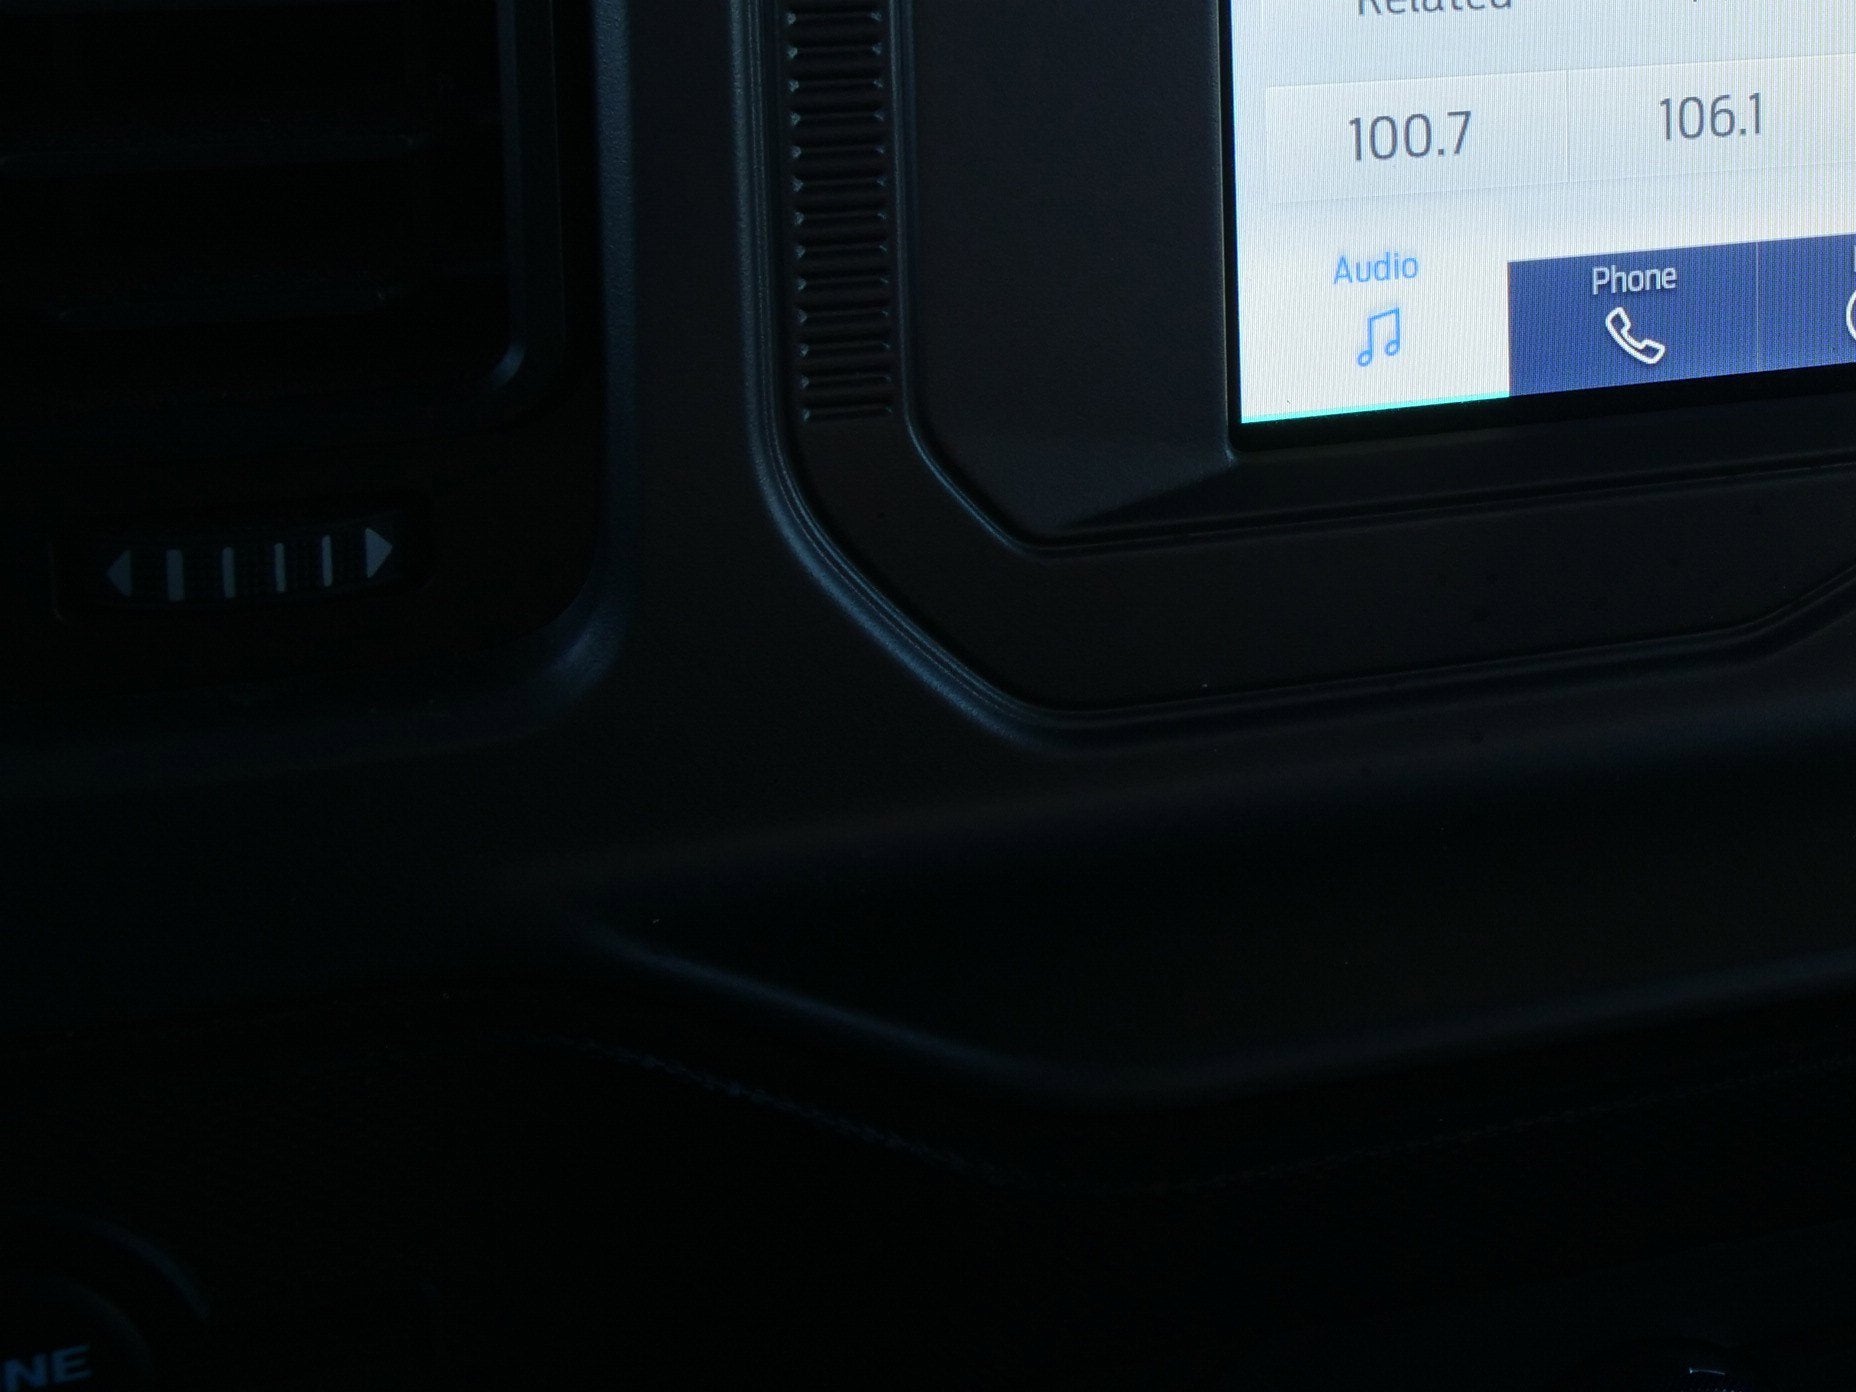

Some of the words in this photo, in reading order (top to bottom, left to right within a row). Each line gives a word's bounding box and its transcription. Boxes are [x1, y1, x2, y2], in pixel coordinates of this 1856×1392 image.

[1349, 109, 1473, 162] 100.7
[1659, 92, 1763, 141] 106.1
[1333, 251, 1420, 285] Audio
[1591, 264, 1678, 296] Phone
